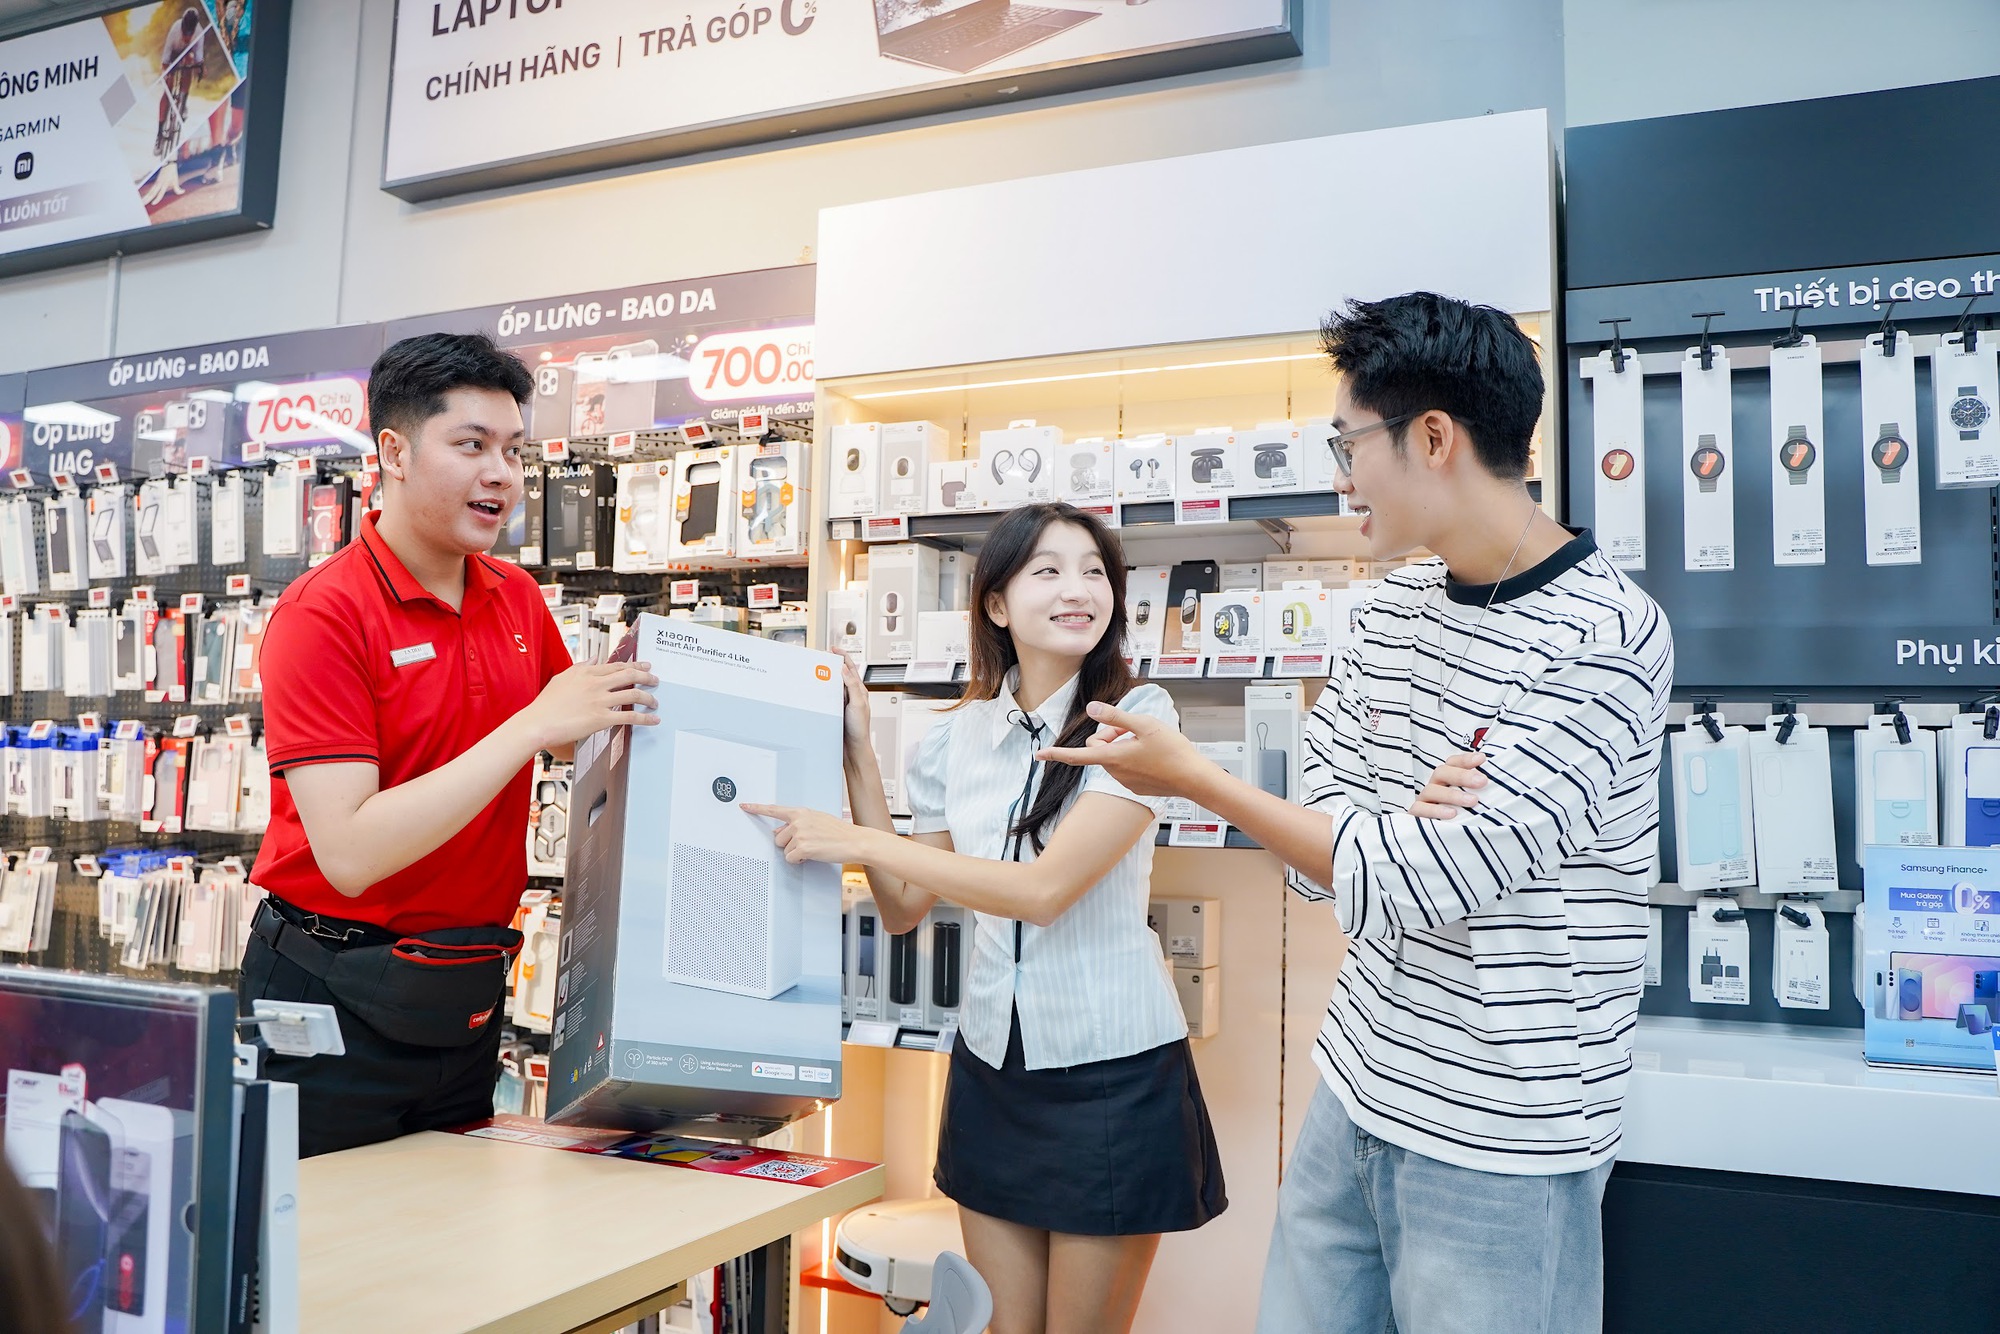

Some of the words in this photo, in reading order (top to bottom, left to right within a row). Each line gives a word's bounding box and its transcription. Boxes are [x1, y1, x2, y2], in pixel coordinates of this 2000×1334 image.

[433, 0, 562, 36] LAP
[426, 61, 511, 101] CHÍNH
[520, 42, 601, 82] HÃNG
[639, 15, 696, 58] TRẢ
[706, 7, 772, 44] GÓP
[44, 55, 99, 89] MINH
[4, 201, 40, 224] LUÔN
[43, 192, 69, 216] TỐT
[1753, 277, 1839, 312] Thiết
[1849, 277, 1880, 311] bị
[1889, 276, 1961, 301] đeo
[498, 305, 531, 337] ỐP
[534, 300, 602, 333] LƯNG
[621, 295, 674, 321] BAO
[679, 287, 716, 315] DA
[108, 357, 135, 387] ỐP
[136, 352, 185, 383] LƯNG
[199, 350, 236, 375] BAO
[239, 346, 269, 371] DA
[656, 637, 681, 649] Smart
[682, 643, 695, 652] Air
[696, 646, 727, 659] Purifier
[728, 652, 733, 660] 4
[734, 652, 750, 664] Lite
[1896, 639, 1962, 673] Phụ
[1900, 864, 1944, 875] Samsung
[1946, 865, 1988, 874] Finance+
[1917, 892, 1943, 901] Galaxy
[1928, 900, 1943, 909] góp
